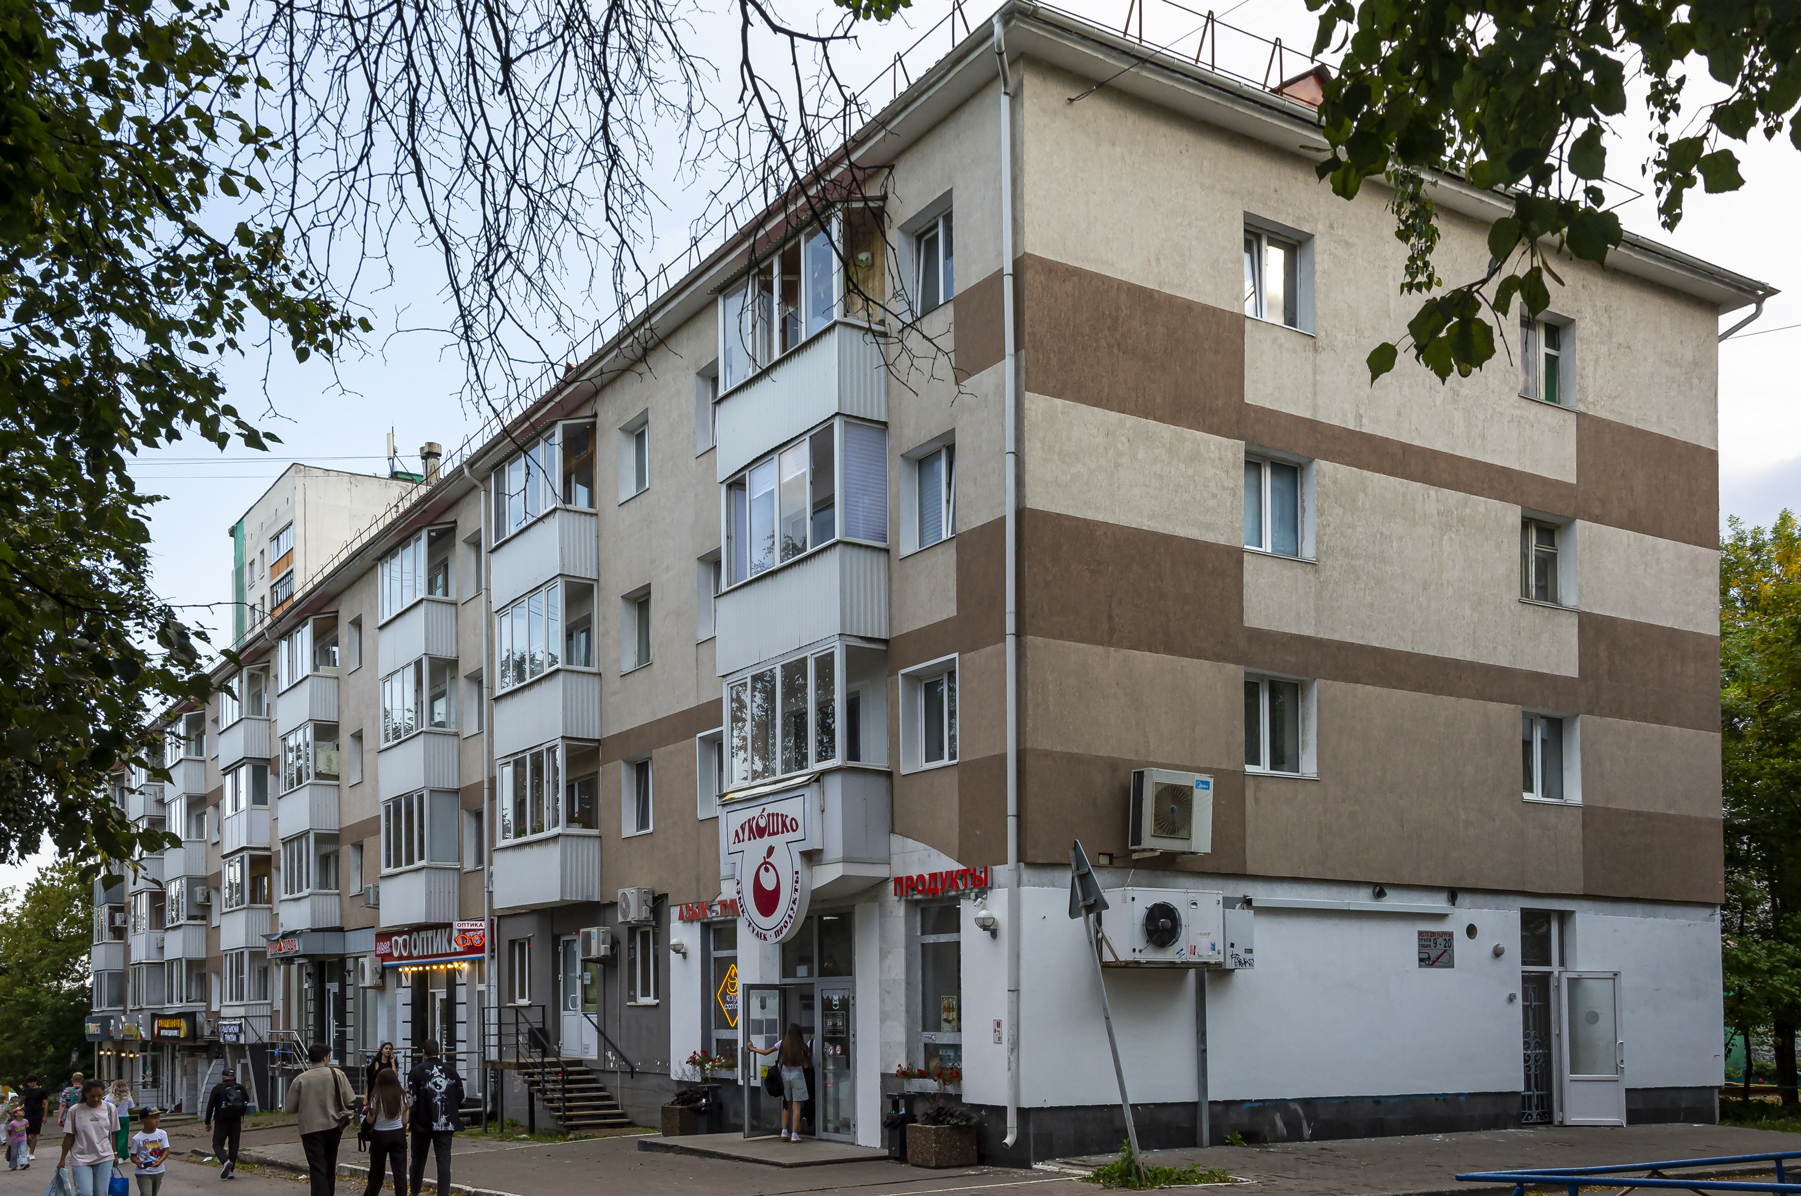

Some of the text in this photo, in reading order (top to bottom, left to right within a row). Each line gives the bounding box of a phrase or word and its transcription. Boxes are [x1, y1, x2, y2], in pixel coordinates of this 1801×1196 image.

[732, 808, 799, 845] ЛУКОШКО
[893, 866, 988, 898] ПРОДУКТЫ
[774, 870, 800, 939] ПРОДУКТЫ
[411, 927, 464, 957] ОПТИКА
